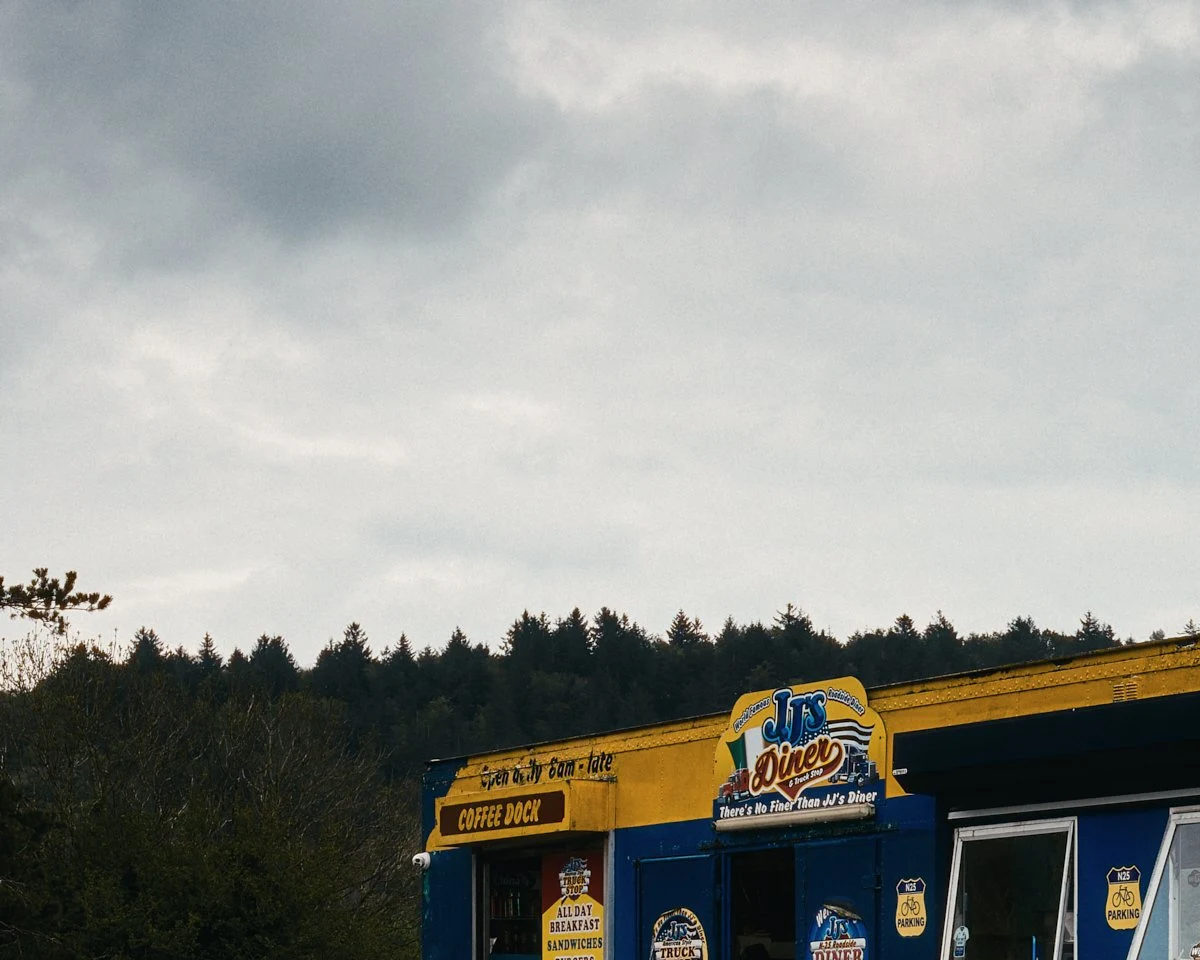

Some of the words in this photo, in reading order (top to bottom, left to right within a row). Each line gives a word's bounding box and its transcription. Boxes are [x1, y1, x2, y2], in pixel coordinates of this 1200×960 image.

[827, 687, 852, 705] Roadside
[849, 697, 866, 716] Diner
[733, 709, 750, 732] World
[749, 697, 770, 718] Famous
[587, 750, 614, 775] late
[750, 735, 843, 796] Diner
[794, 774, 810, 787] Truck
[810, 768, 824, 781] Stop
[719, 803, 753, 819] There's
[755, 802, 768, 815] No
[770, 799, 795, 812] Finer
[797, 796, 820, 810] Than
[823, 793, 845, 808] JJ's
[848, 790, 878, 804] Diner
[457, 803, 503, 832] COFFEE
[503, 798, 542, 826] DOCK
[562, 875, 587, 886] TRUCK
[1117, 870, 1131, 881] N25
[565, 885, 584, 895] STOP
[904, 882, 917, 892] N25
[556, 905, 573, 919] ALL
[574, 904, 593, 917] DAY
[1107, 908, 1140, 921] PARKING
[549, 918, 600, 933] BREAKFAST
[897, 917, 925, 929] PARKING
[547, 937, 603, 951] SANDWICHES
[681, 939, 693, 947] Style
[833, 939, 857, 948] Roadside
[660, 946, 696, 959] TRUCK
